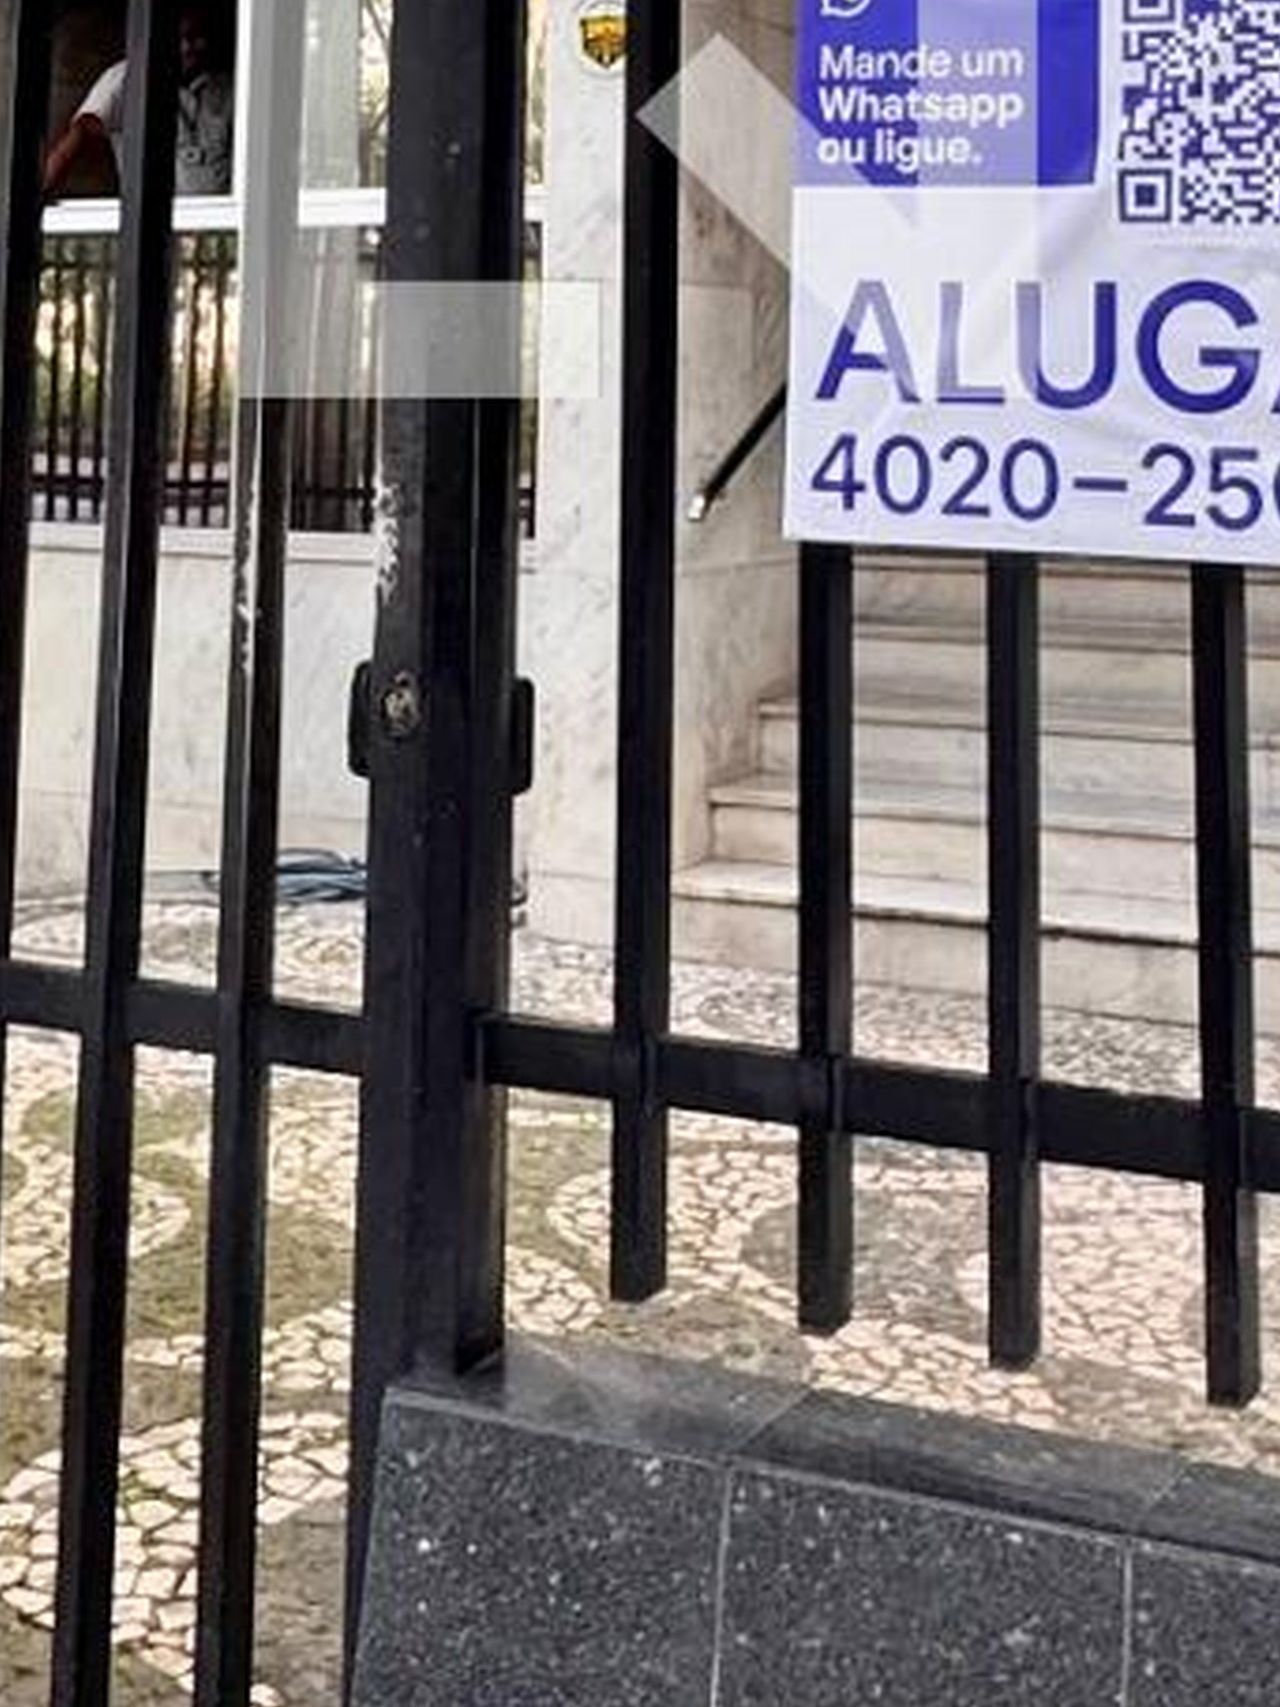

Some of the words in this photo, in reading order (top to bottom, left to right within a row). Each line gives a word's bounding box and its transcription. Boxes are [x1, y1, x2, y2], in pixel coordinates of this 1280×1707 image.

[819, 45, 952, 80] Mande
[961, 47, 1023, 78] um
[818, 87, 1024, 129] Whatsapp
[819, 137, 865, 164] ou
[875, 127, 983, 174] ligue.
